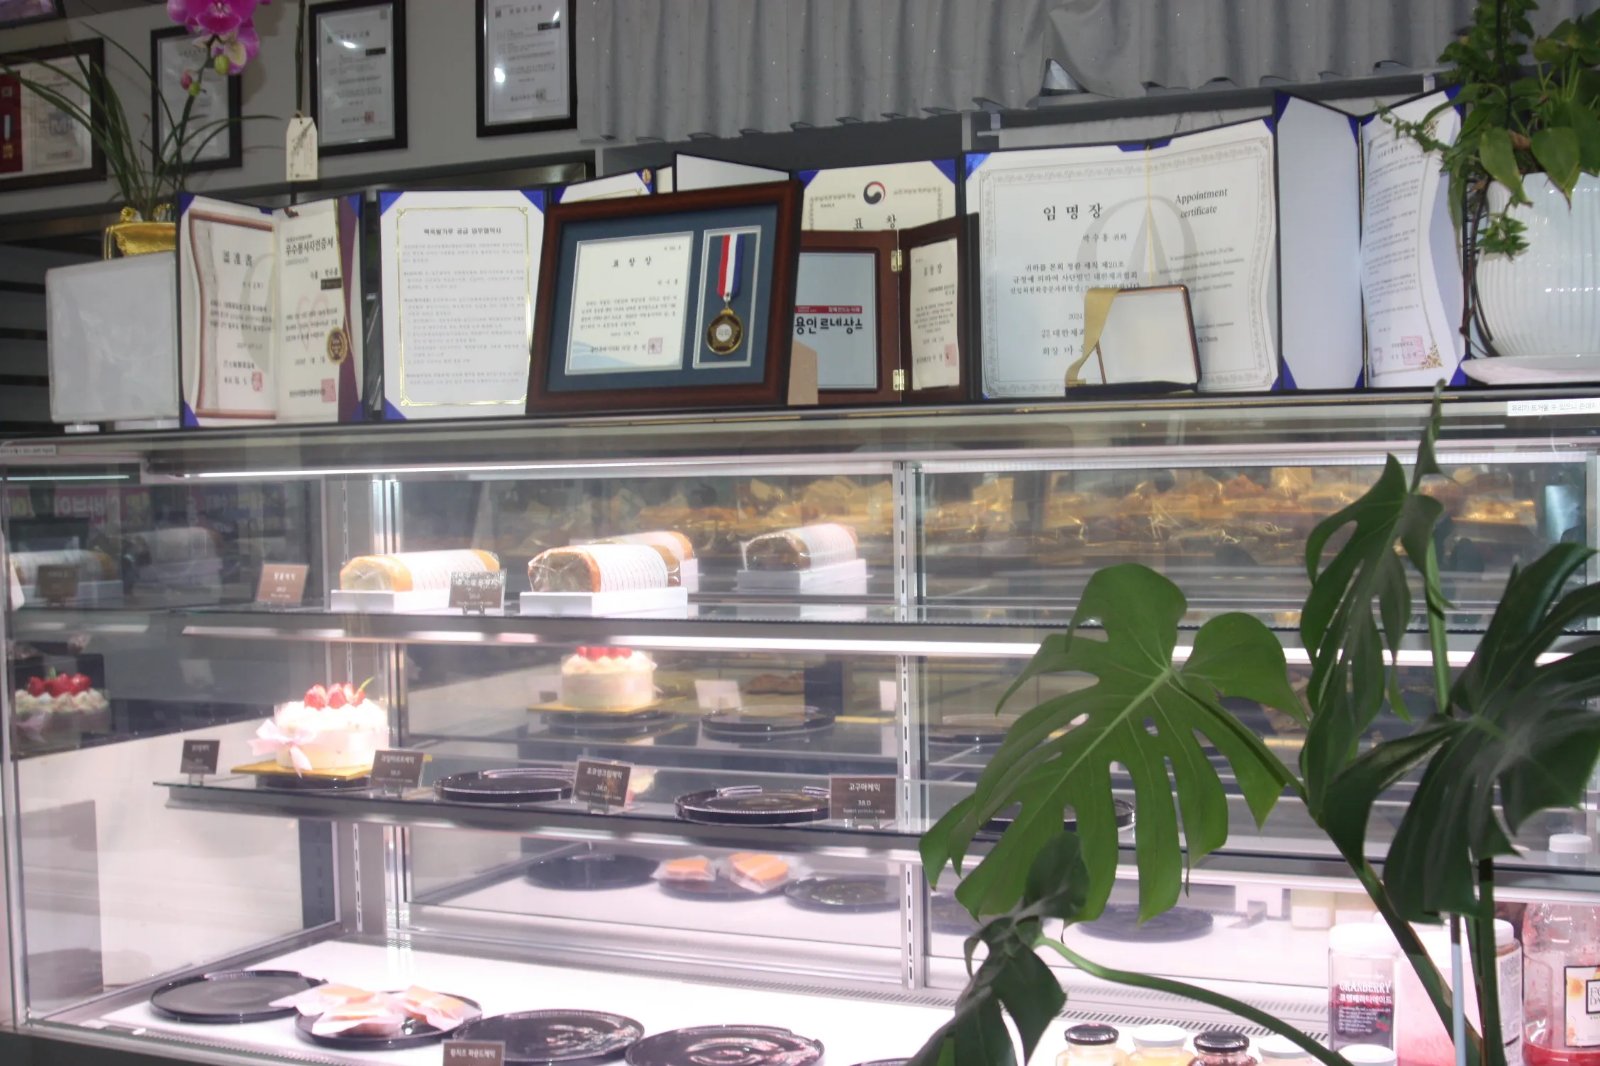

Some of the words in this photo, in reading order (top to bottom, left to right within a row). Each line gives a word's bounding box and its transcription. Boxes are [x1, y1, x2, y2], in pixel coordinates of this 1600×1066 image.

[1175, 188, 1228, 206] Appointment
[1180, 206, 1218, 219] certificate
[795, 316, 817, 335] 용인
[820, 316, 863, 335] 르네상스
[848, 782, 881, 792] 고구마케익
[1339, 980, 1392, 994] CRANBERRY
